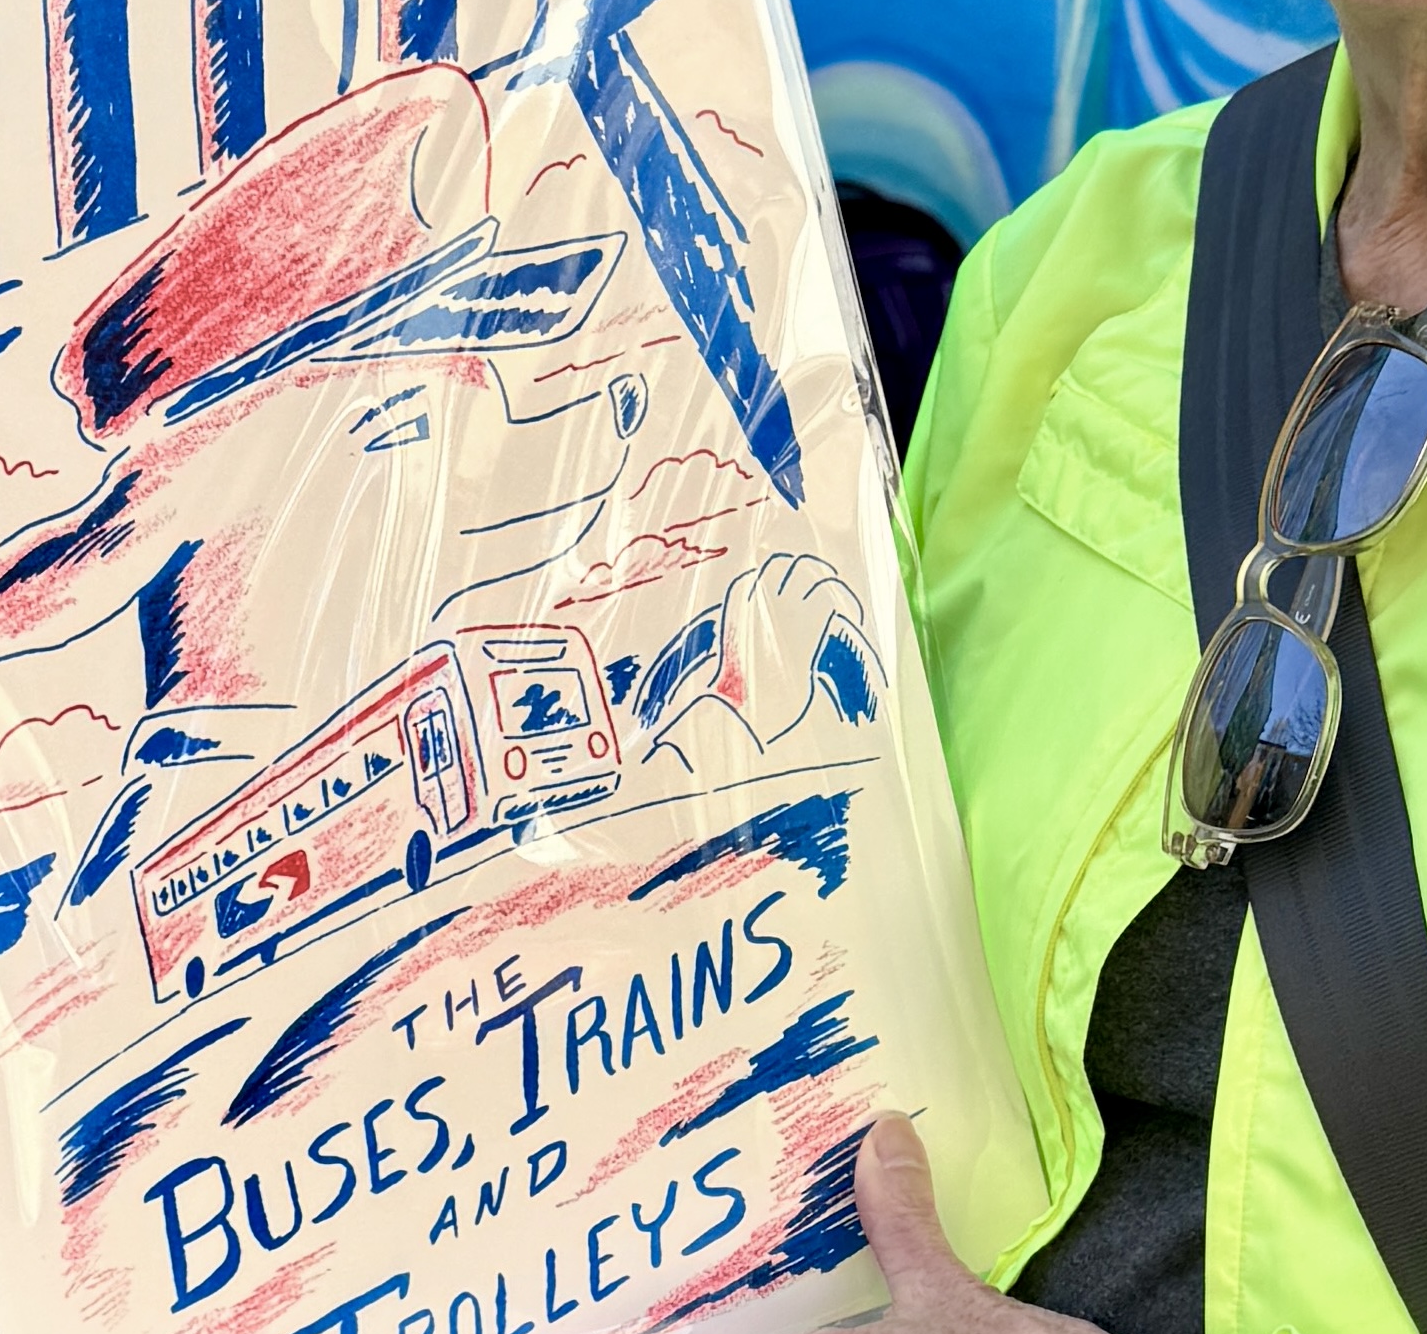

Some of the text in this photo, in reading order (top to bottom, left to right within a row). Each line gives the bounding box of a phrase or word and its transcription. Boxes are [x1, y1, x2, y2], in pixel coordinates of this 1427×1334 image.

[393, 954, 526, 1049] THE
[144, 891, 792, 1314] BUSES, TRAINS
[429, 1141, 567, 1245] AND
